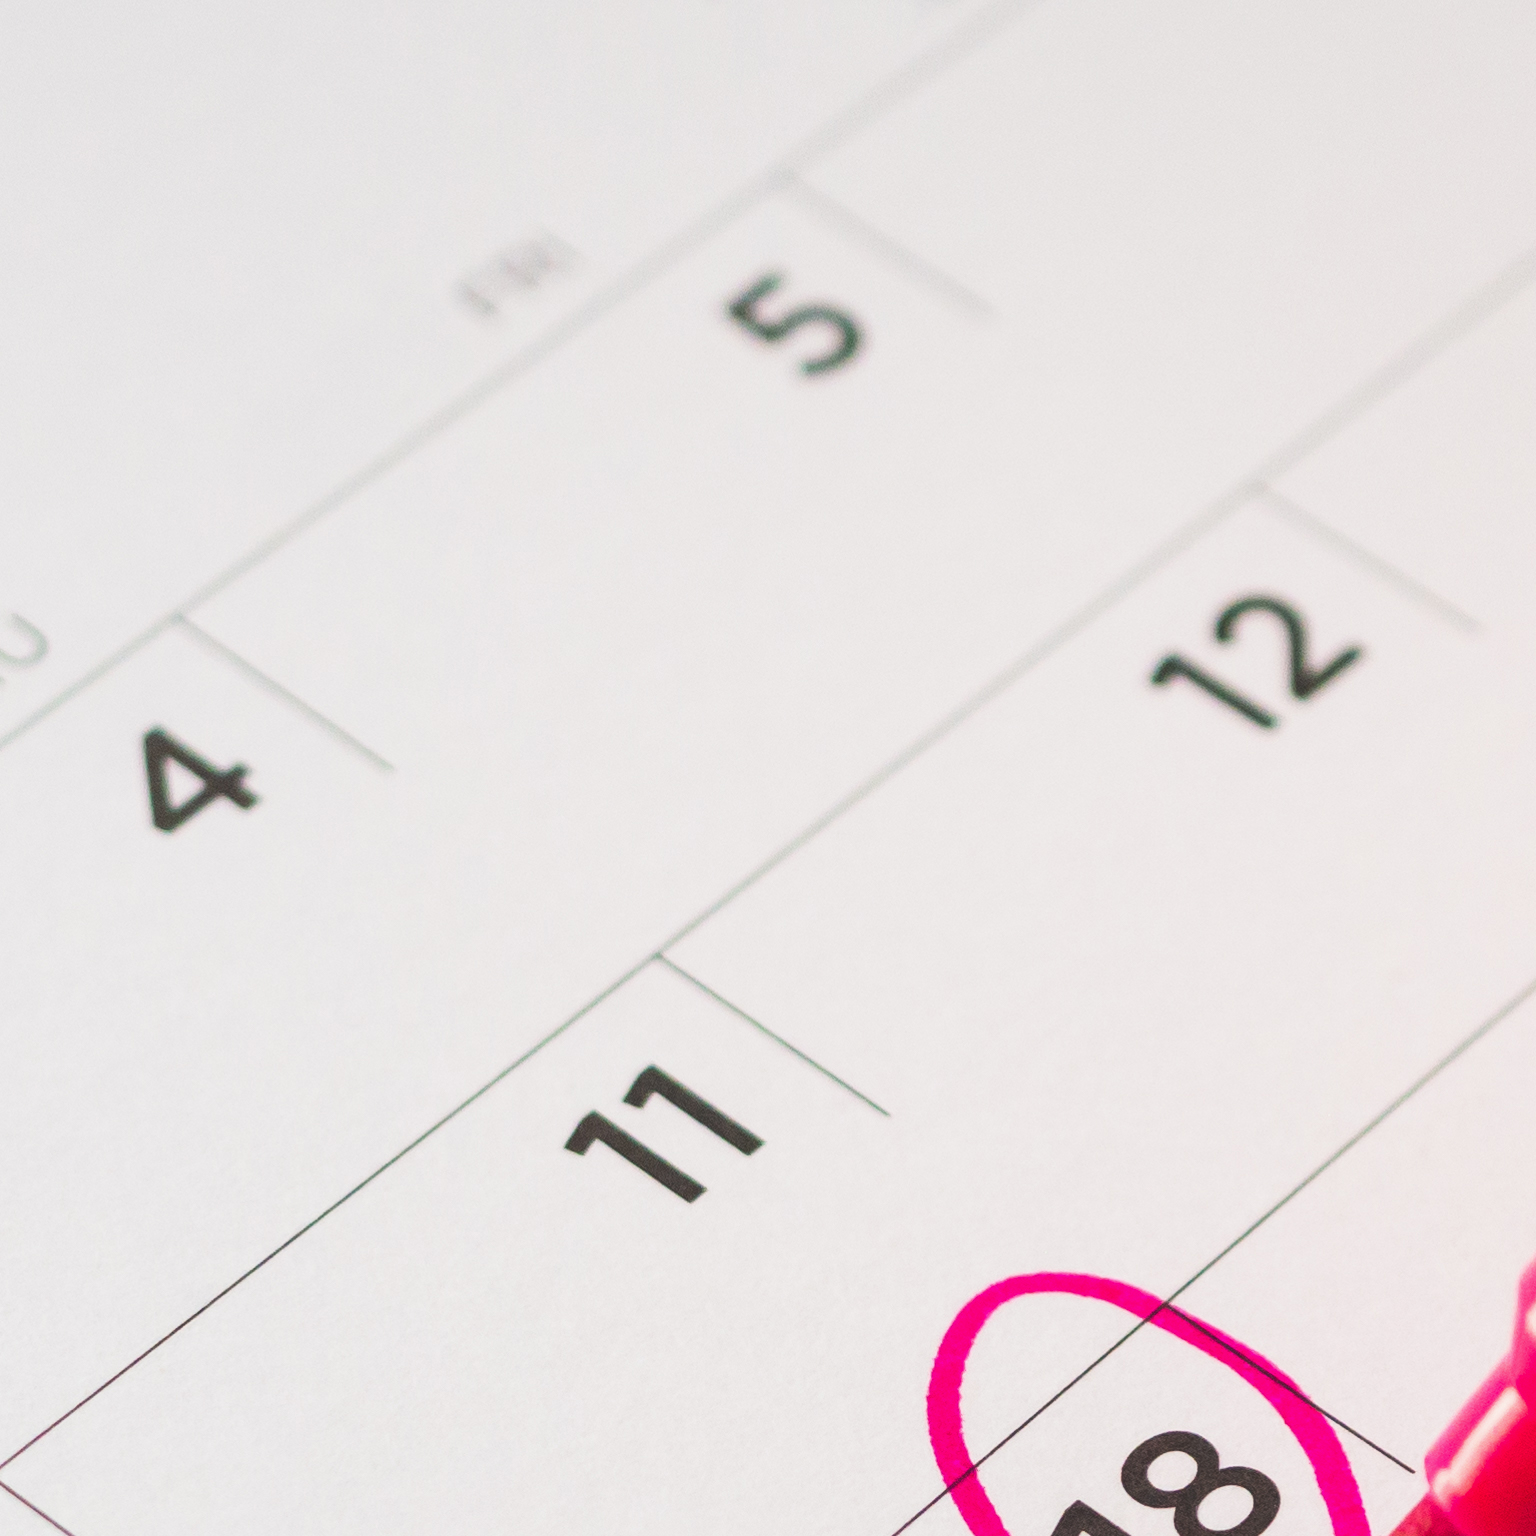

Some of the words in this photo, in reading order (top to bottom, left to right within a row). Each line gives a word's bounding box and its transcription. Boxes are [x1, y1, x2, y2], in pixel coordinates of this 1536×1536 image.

[725, 273, 866, 379] 5
[1150, 593, 1363, 731] 12
[141, 726, 261, 836] 4
[563, 1064, 765, 1205] 11
